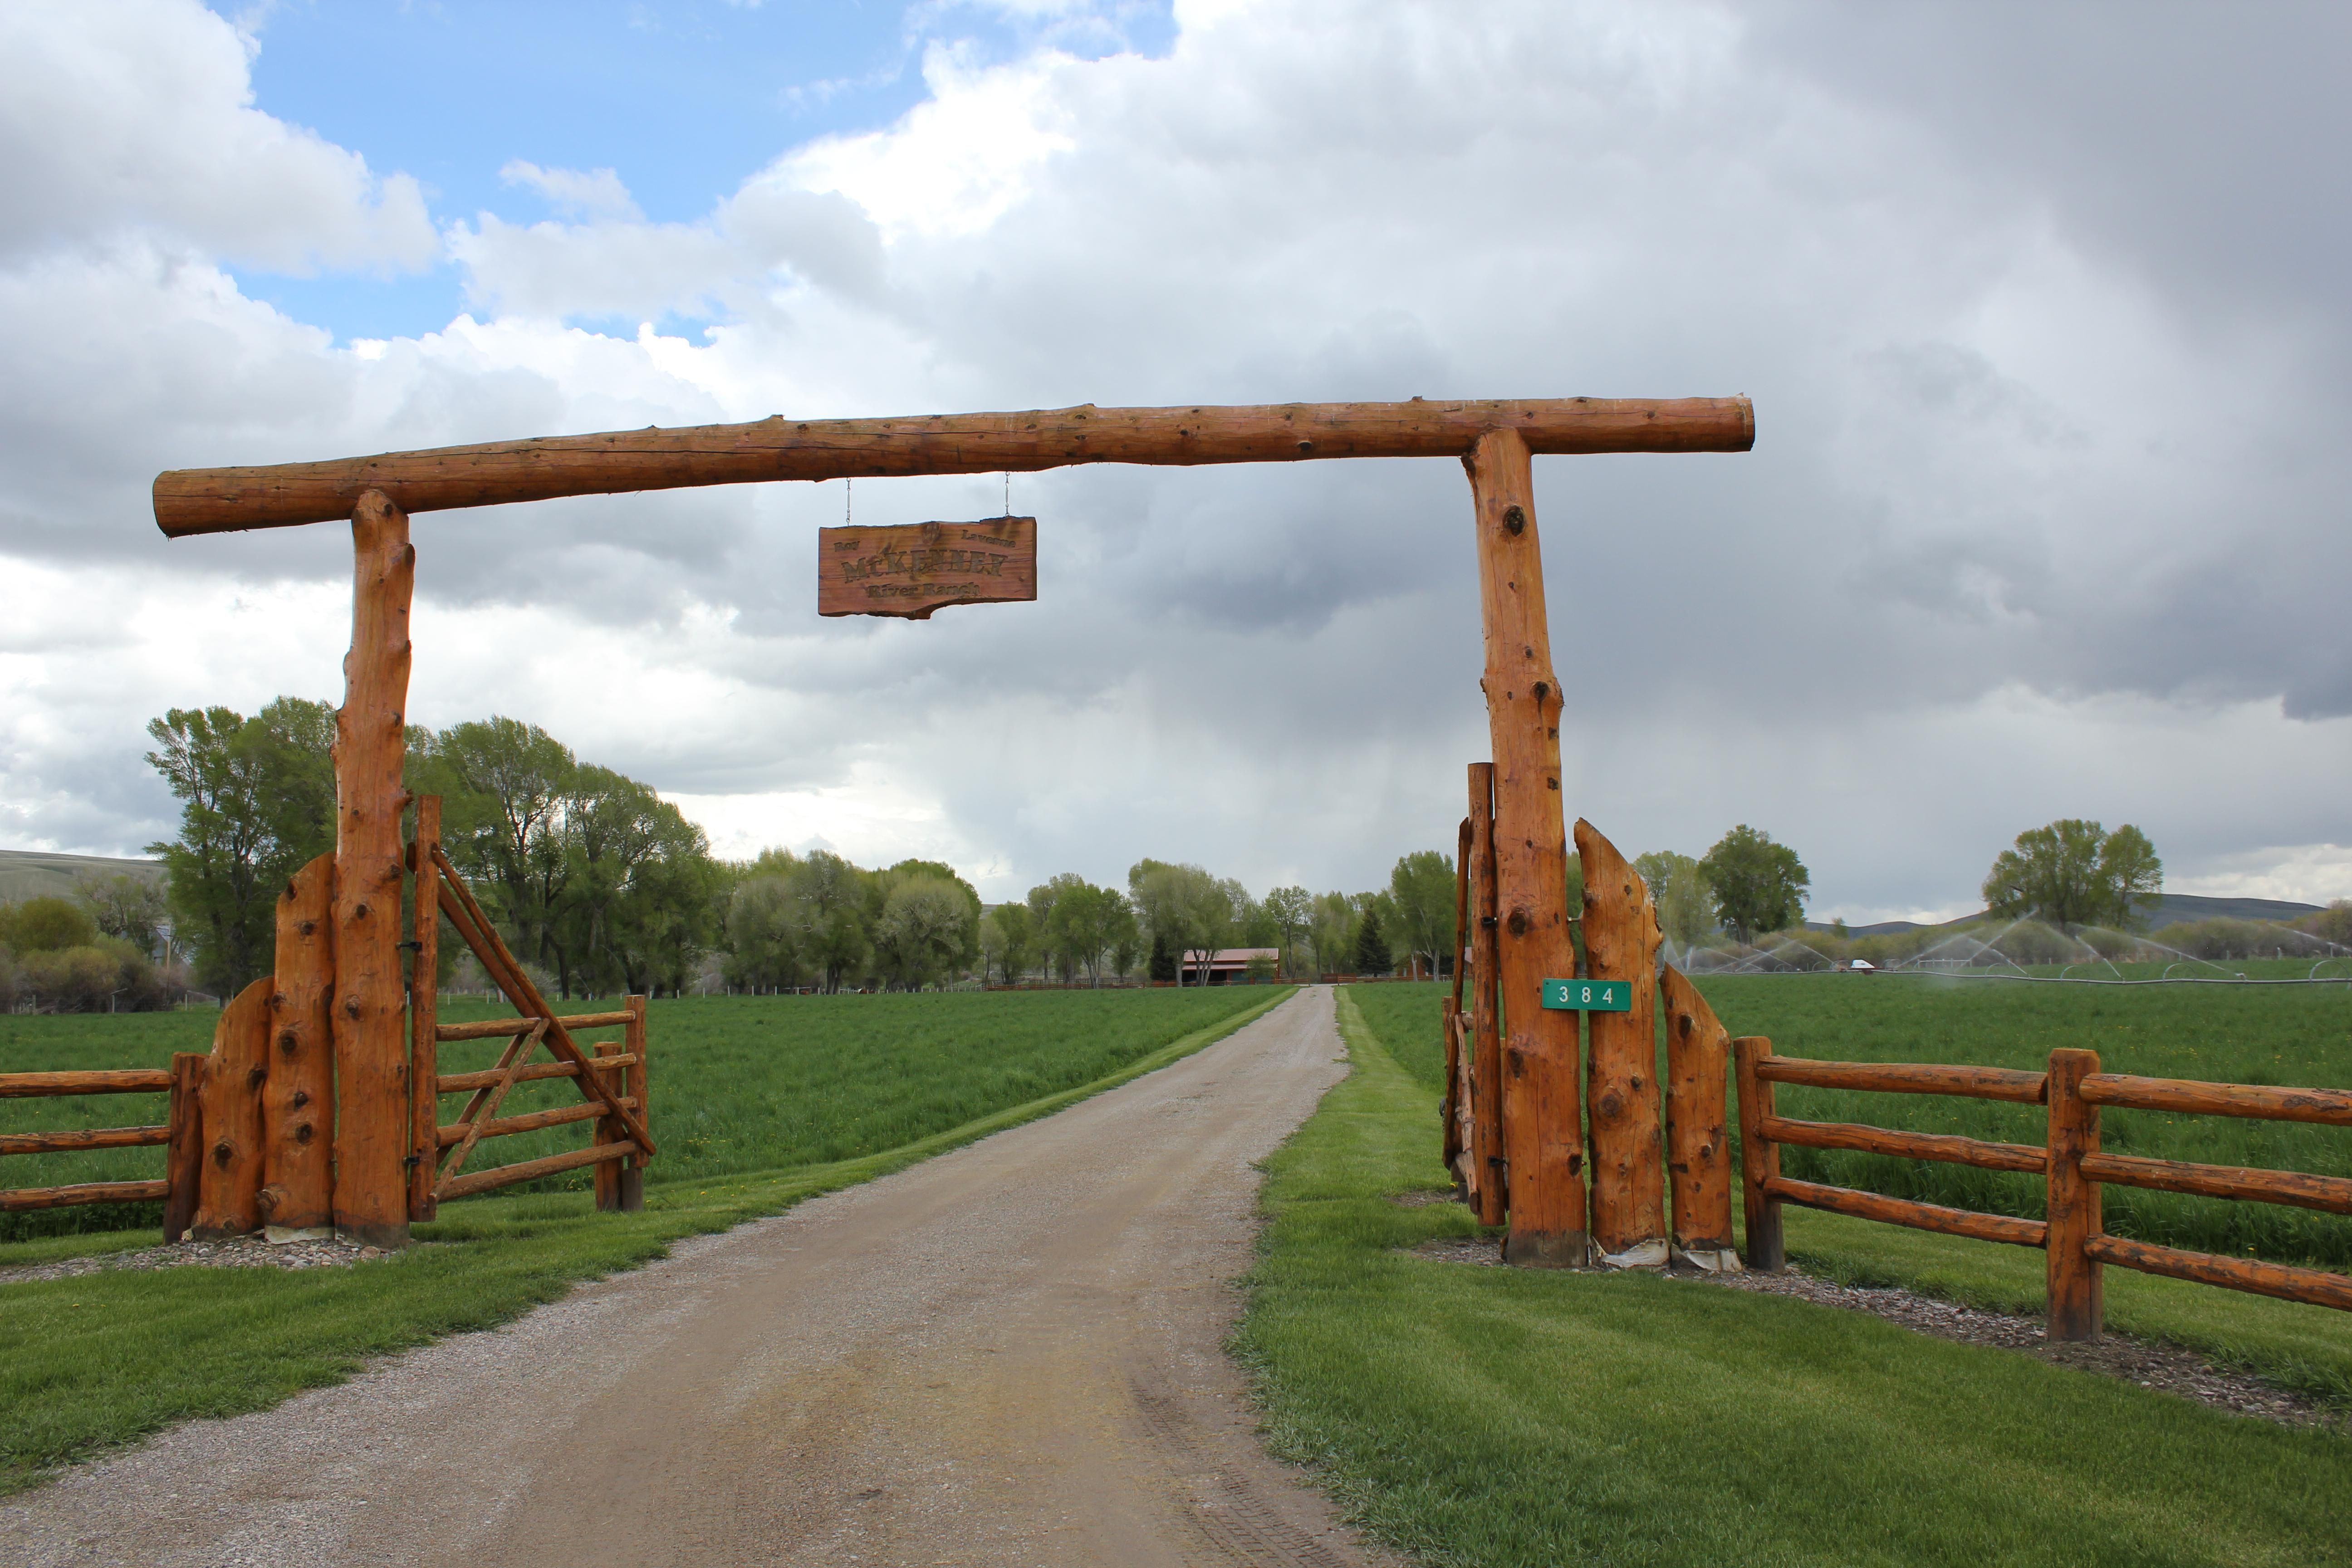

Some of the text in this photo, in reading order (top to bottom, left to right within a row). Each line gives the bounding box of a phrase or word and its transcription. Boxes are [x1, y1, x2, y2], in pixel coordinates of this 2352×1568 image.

[833, 540, 861, 552] Roy
[961, 529, 1017, 548] Laverne
[867, 582, 980, 598] River Ranch
[1558, 986, 1613, 1004] 384
